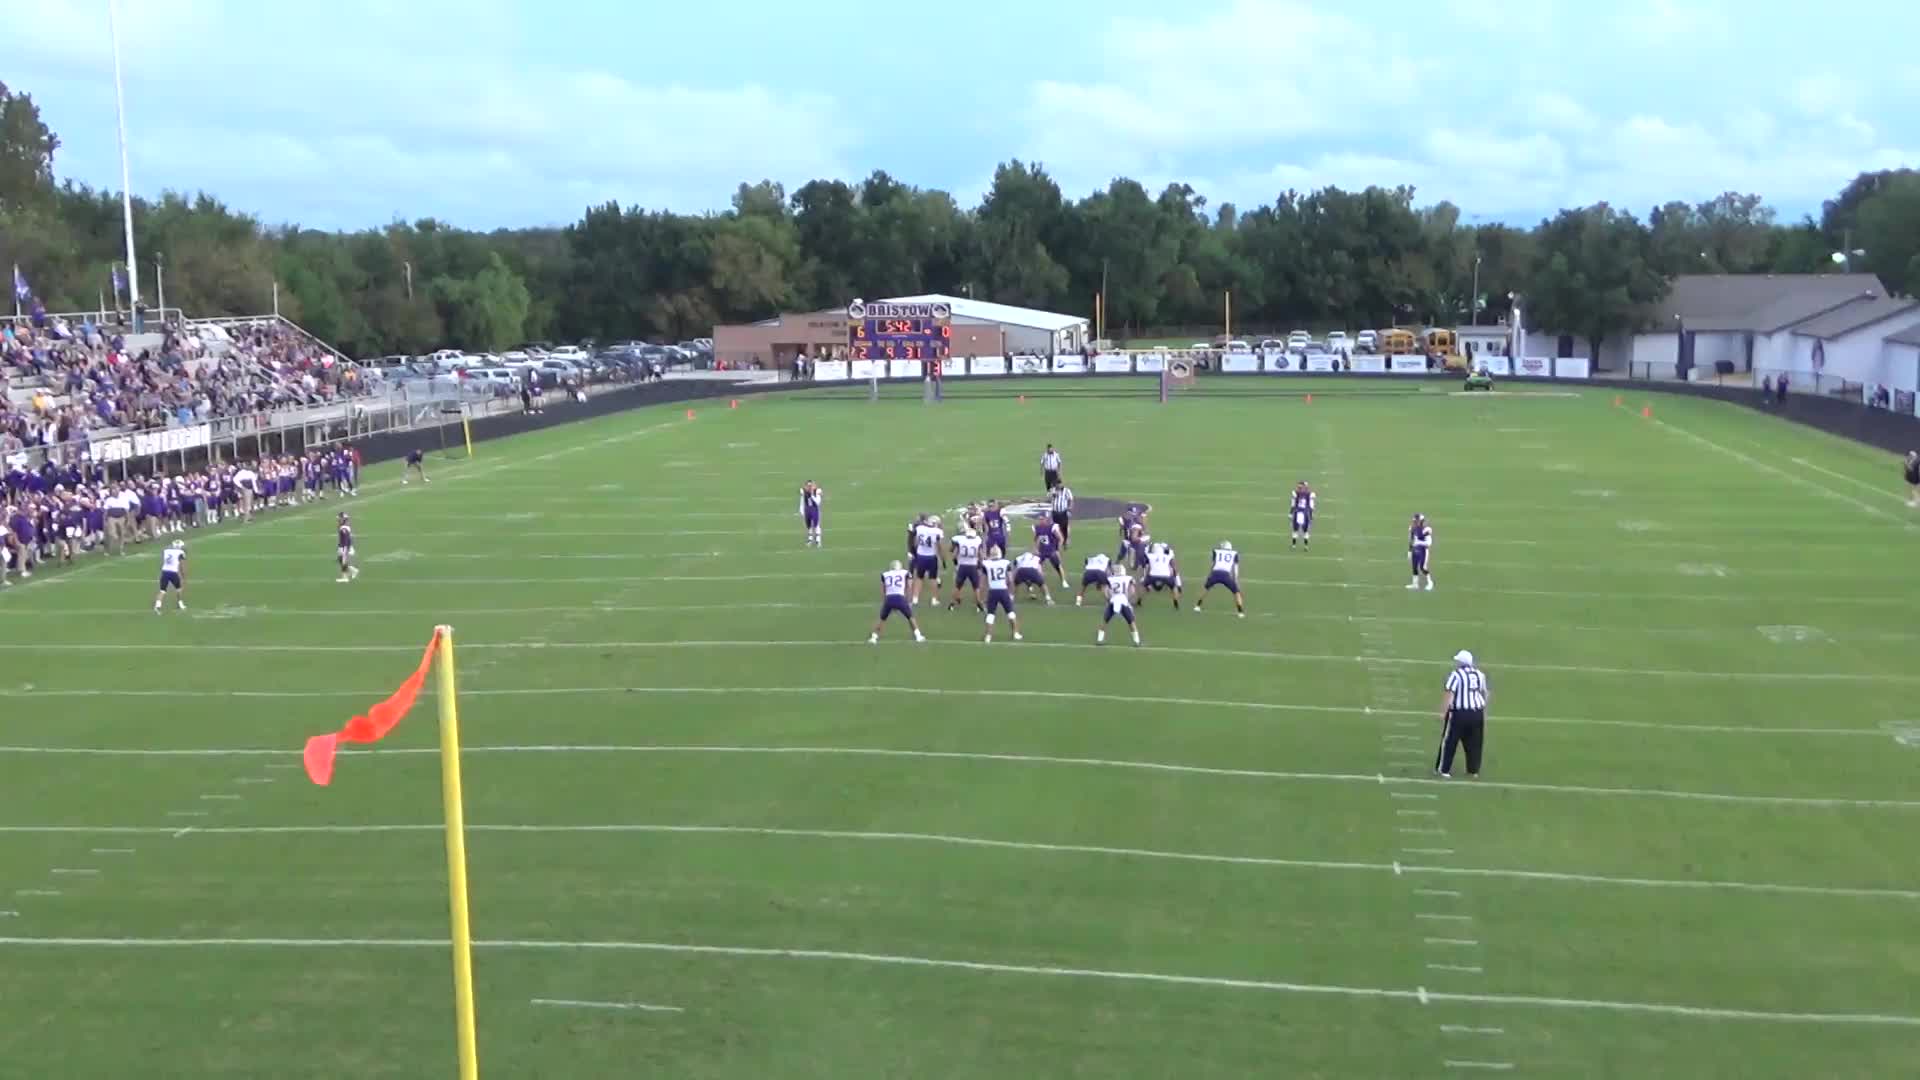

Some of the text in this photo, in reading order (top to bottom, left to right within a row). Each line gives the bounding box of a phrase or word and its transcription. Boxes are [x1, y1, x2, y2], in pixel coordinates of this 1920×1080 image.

[868, 305, 930, 316] BRISTOW
[857, 326, 865, 337] 6
[990, 567, 1005, 580] 12
[1112, 581, 1127, 594] 21
